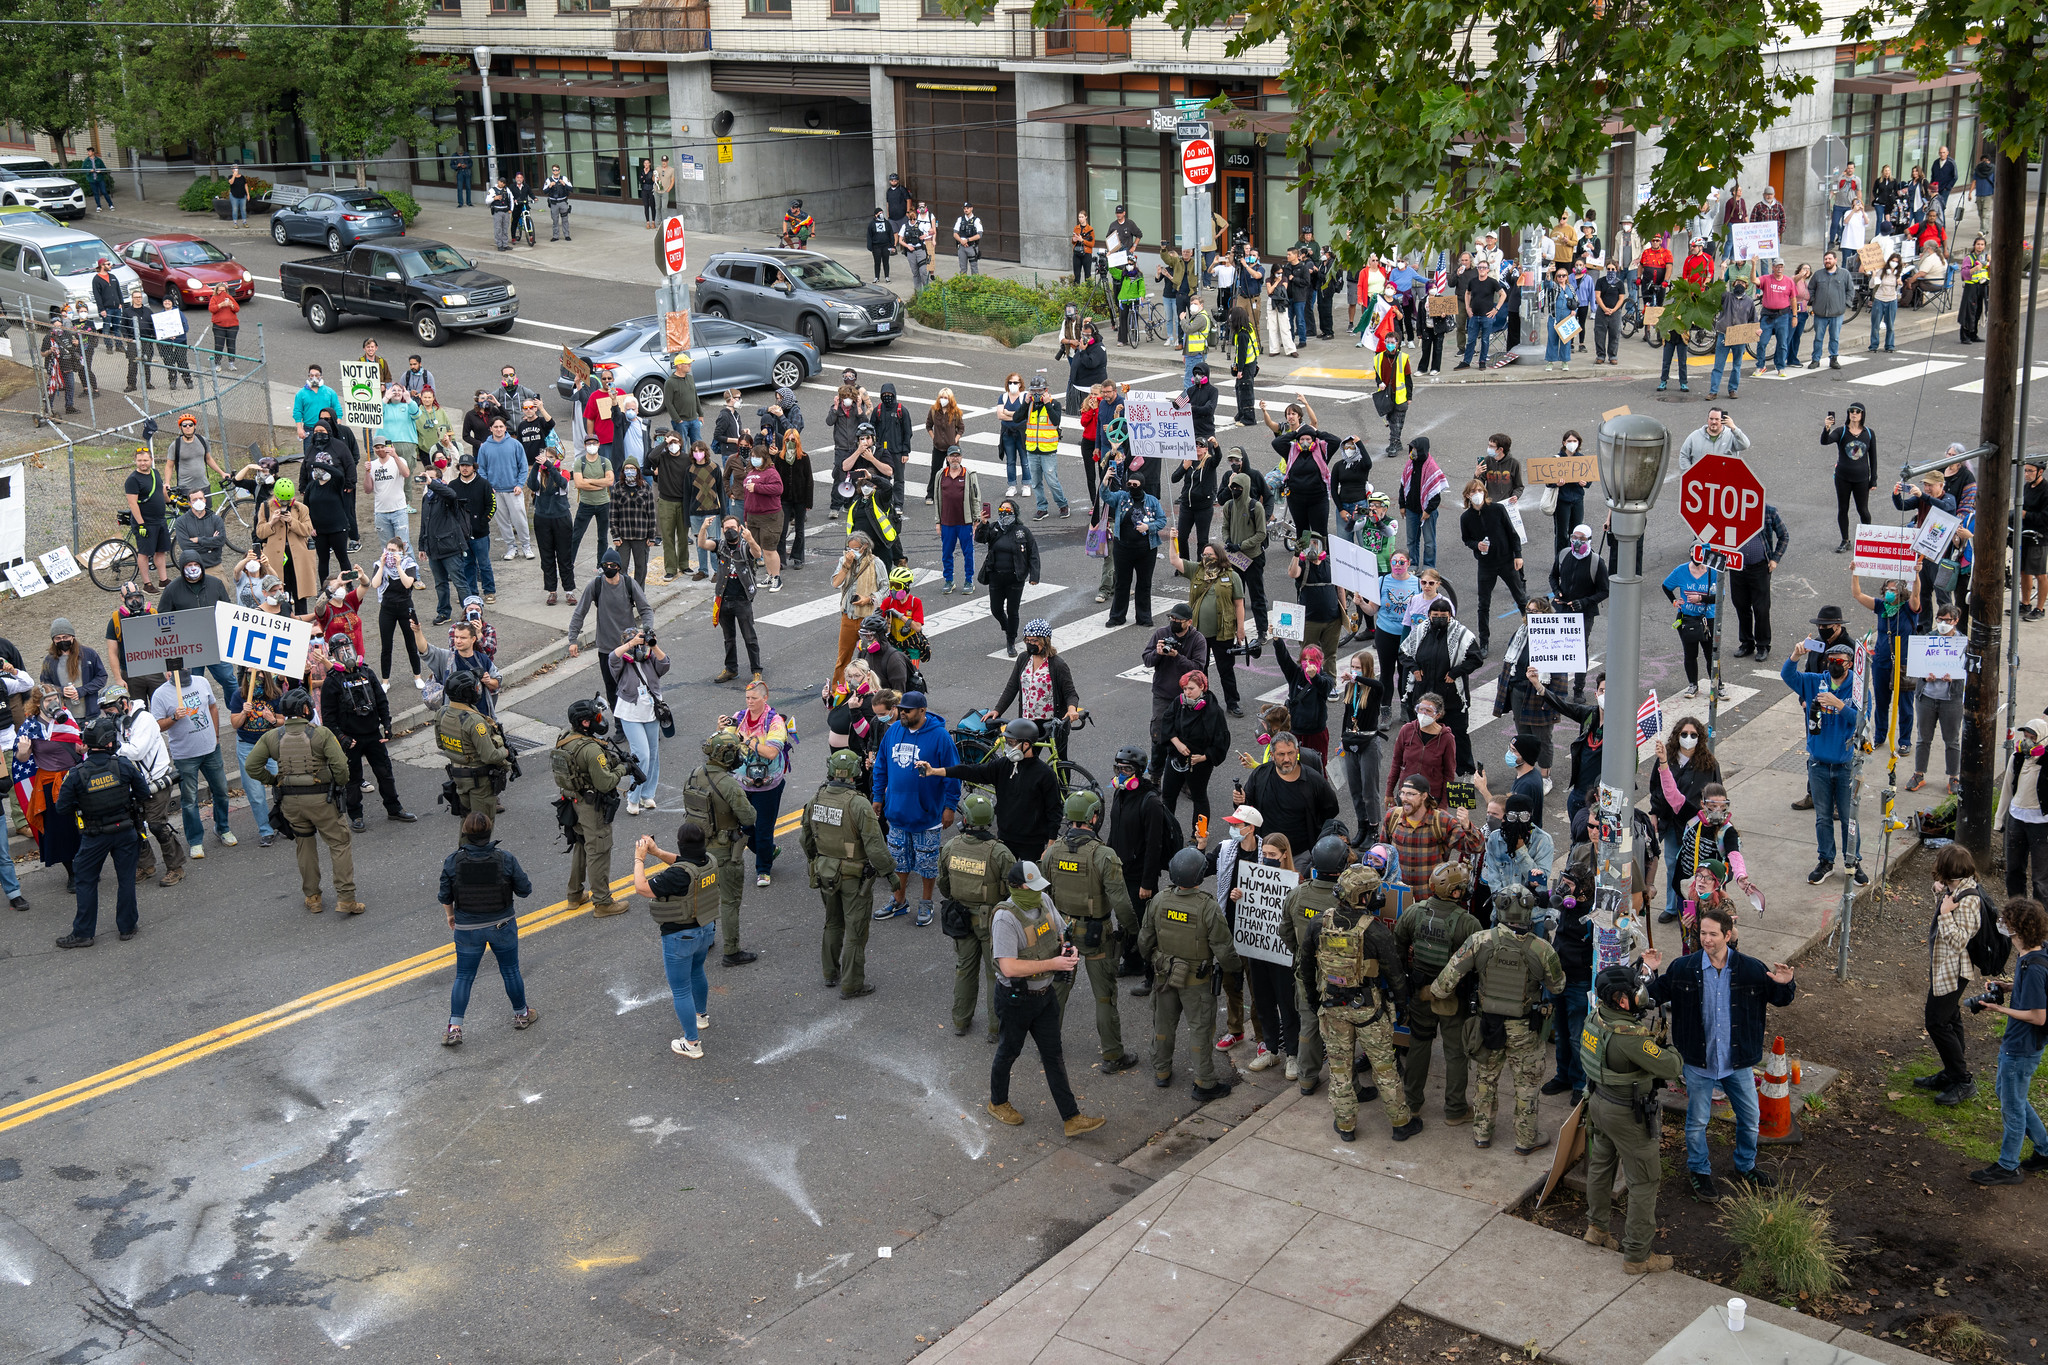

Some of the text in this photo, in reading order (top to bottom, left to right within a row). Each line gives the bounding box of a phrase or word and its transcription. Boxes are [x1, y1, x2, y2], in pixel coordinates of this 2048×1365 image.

[1161, 116, 1184, 127] REAC
[1190, 127, 1199, 135] WAY
[1198, 147, 1209, 156] NOT
[1228, 154, 1250, 164] 4150
[1190, 168, 1209, 178] ENTER
[667, 226, 682, 238] DO NOT
[670, 252, 681, 264] ENTER
[342, 365, 378, 379] NOT UR
[1129, 405, 1151, 422] NO
[1129, 423, 1156, 439] YES
[1133, 440, 1155, 455] NO
[1532, 464, 1555, 482] ICE
[1571, 457, 1595, 478] PDX
[1686, 480, 1759, 521] STOP
[48, 552, 59, 561] NO
[1237, 553, 1249, 564] OUT
[157, 616, 175, 627] ICE
[233, 610, 291, 632] ABOLISH
[154, 634, 179, 647] NAZI
[1272, 627, 1300, 640] CRUSHED
[226, 625, 291, 671] ICE
[1929, 637, 1952, 647] ICE
[126, 643, 202, 663] BROWNSHIRTS
[182, 690, 199, 699] BOLISH
[440, 734, 462, 748] POLICE
[90, 774, 114, 787] POLICE
[814, 804, 843, 819] FEDERAL OFFICER
[951, 856, 986, 870] Federal
[1059, 861, 1078, 872] POLICE
[702, 873, 716, 888] ERO
[1248, 866, 1281, 882] YOUR
[1244, 892, 1284, 909] IS MOR
[1168, 909, 1187, 922] POLICE
[1238, 904, 1282, 922] IMPORTAN
[1037, 922, 1050, 936] HSI
[1238, 917, 1280, 936] THAN YOU
[1420, 924, 1445, 938] POLICE
[1235, 930, 1270, 950] ORDERS
[1583, 1029, 1598, 1048] POLICE
